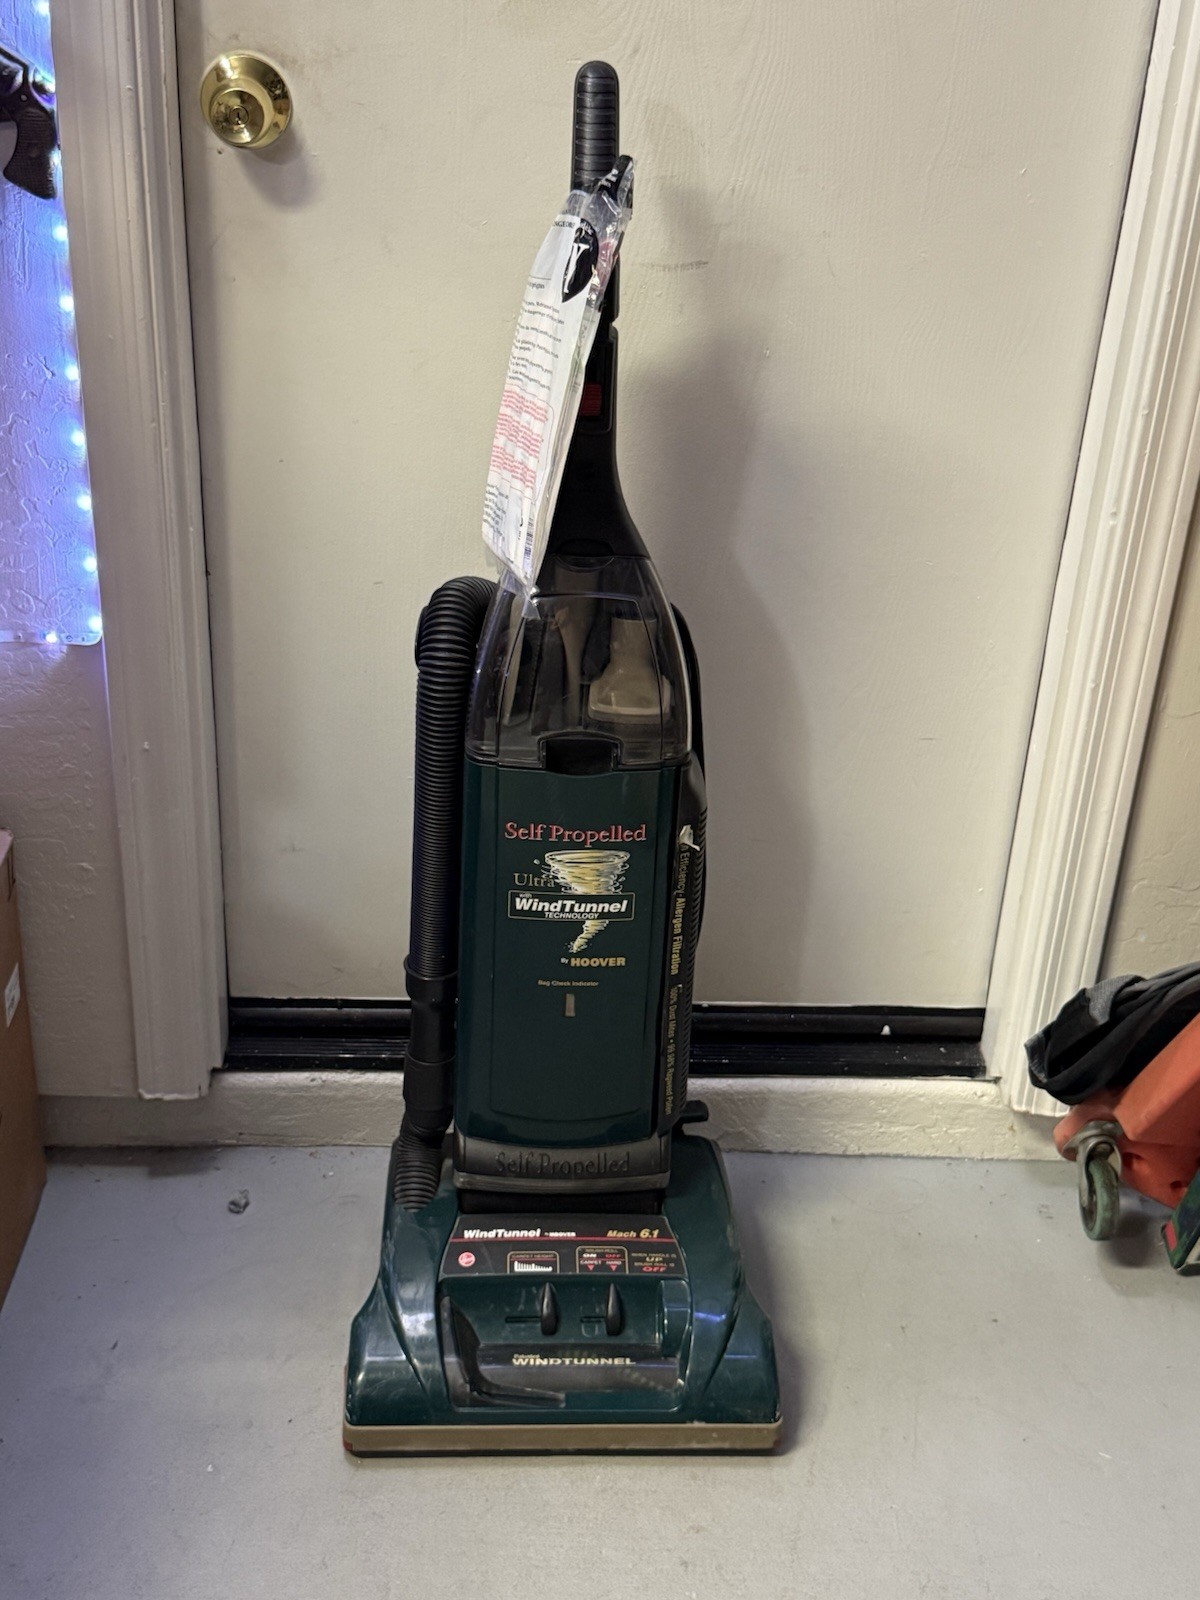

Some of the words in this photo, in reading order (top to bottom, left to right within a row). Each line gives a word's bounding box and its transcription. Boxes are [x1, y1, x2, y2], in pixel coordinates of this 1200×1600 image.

[504, 822, 546, 842] Self
[549, 823, 647, 848] Propelled
[513, 872, 555, 888] Ultra
[514, 897, 628, 913] WindTunnel
[544, 911, 600, 920] TECHNOLOGY
[672, 898, 687, 935] Allergen
[570, 956, 626, 968] HOOVER
[670, 935, 684, 975] Filtration
[538, 979, 551, 987] Bag
[495, 1151, 535, 1174] Self
[537, 1151, 631, 1176] Propelled
[463, 1227, 541, 1239] WindTunnel
[606, 1229, 637, 1239] Mach
[639, 1228, 660, 1239] 6.1
[512, 1357, 637, 1366] WINDTUNNEL
